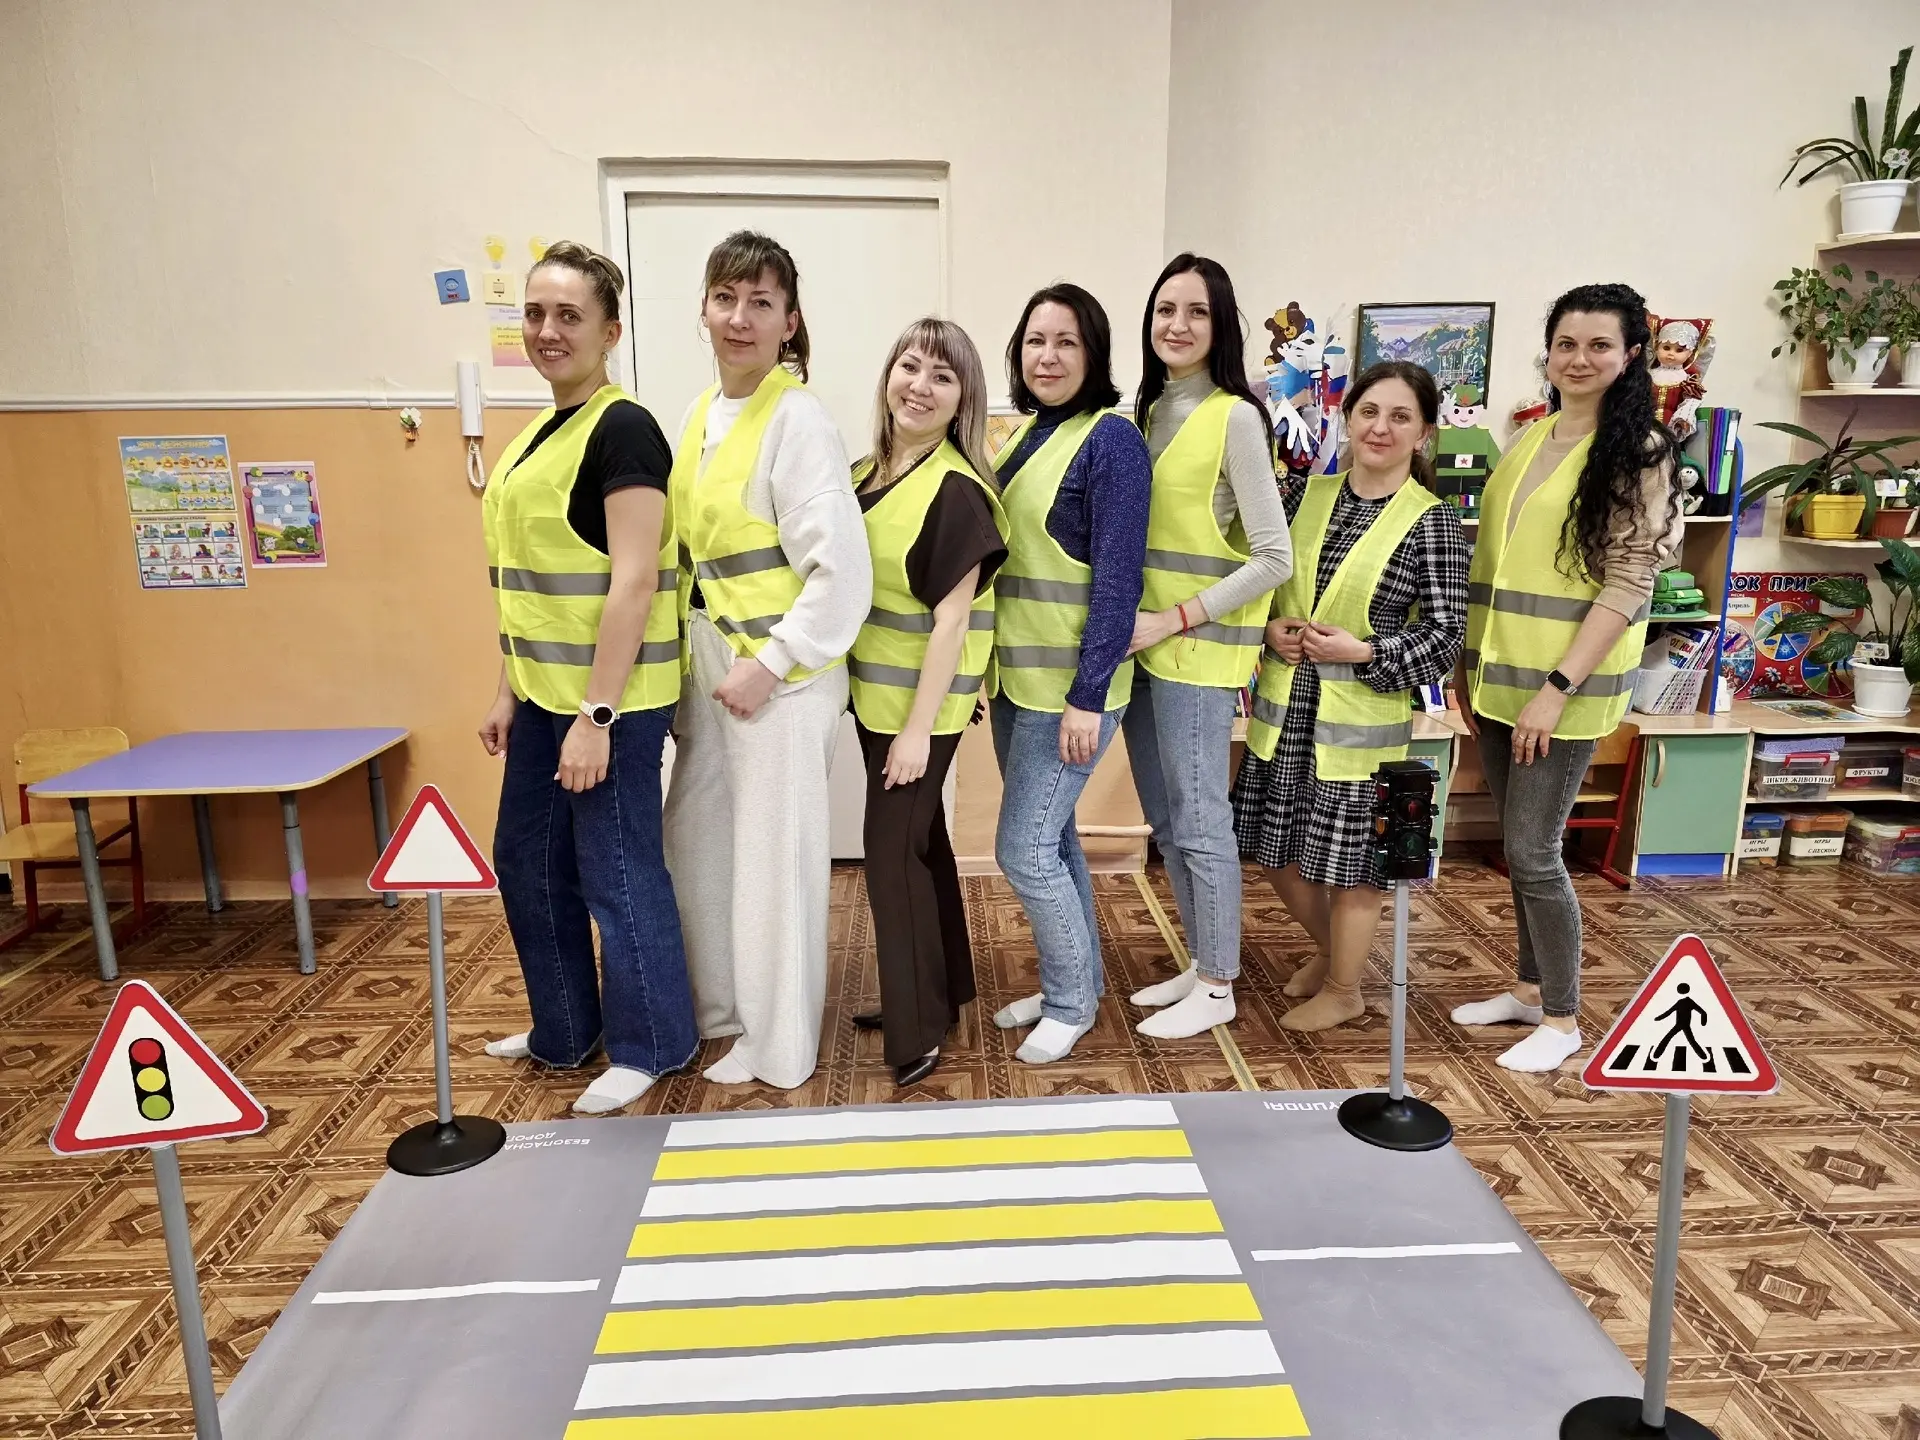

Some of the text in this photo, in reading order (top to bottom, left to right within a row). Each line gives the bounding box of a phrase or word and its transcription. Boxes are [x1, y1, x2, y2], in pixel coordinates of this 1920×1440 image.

[1263, 1101, 1343, 1111] YUNDAI
[506, 1132, 556, 1142] ДОРОГ
[504, 1139, 590, 1150] БЕЗОПАСНА
